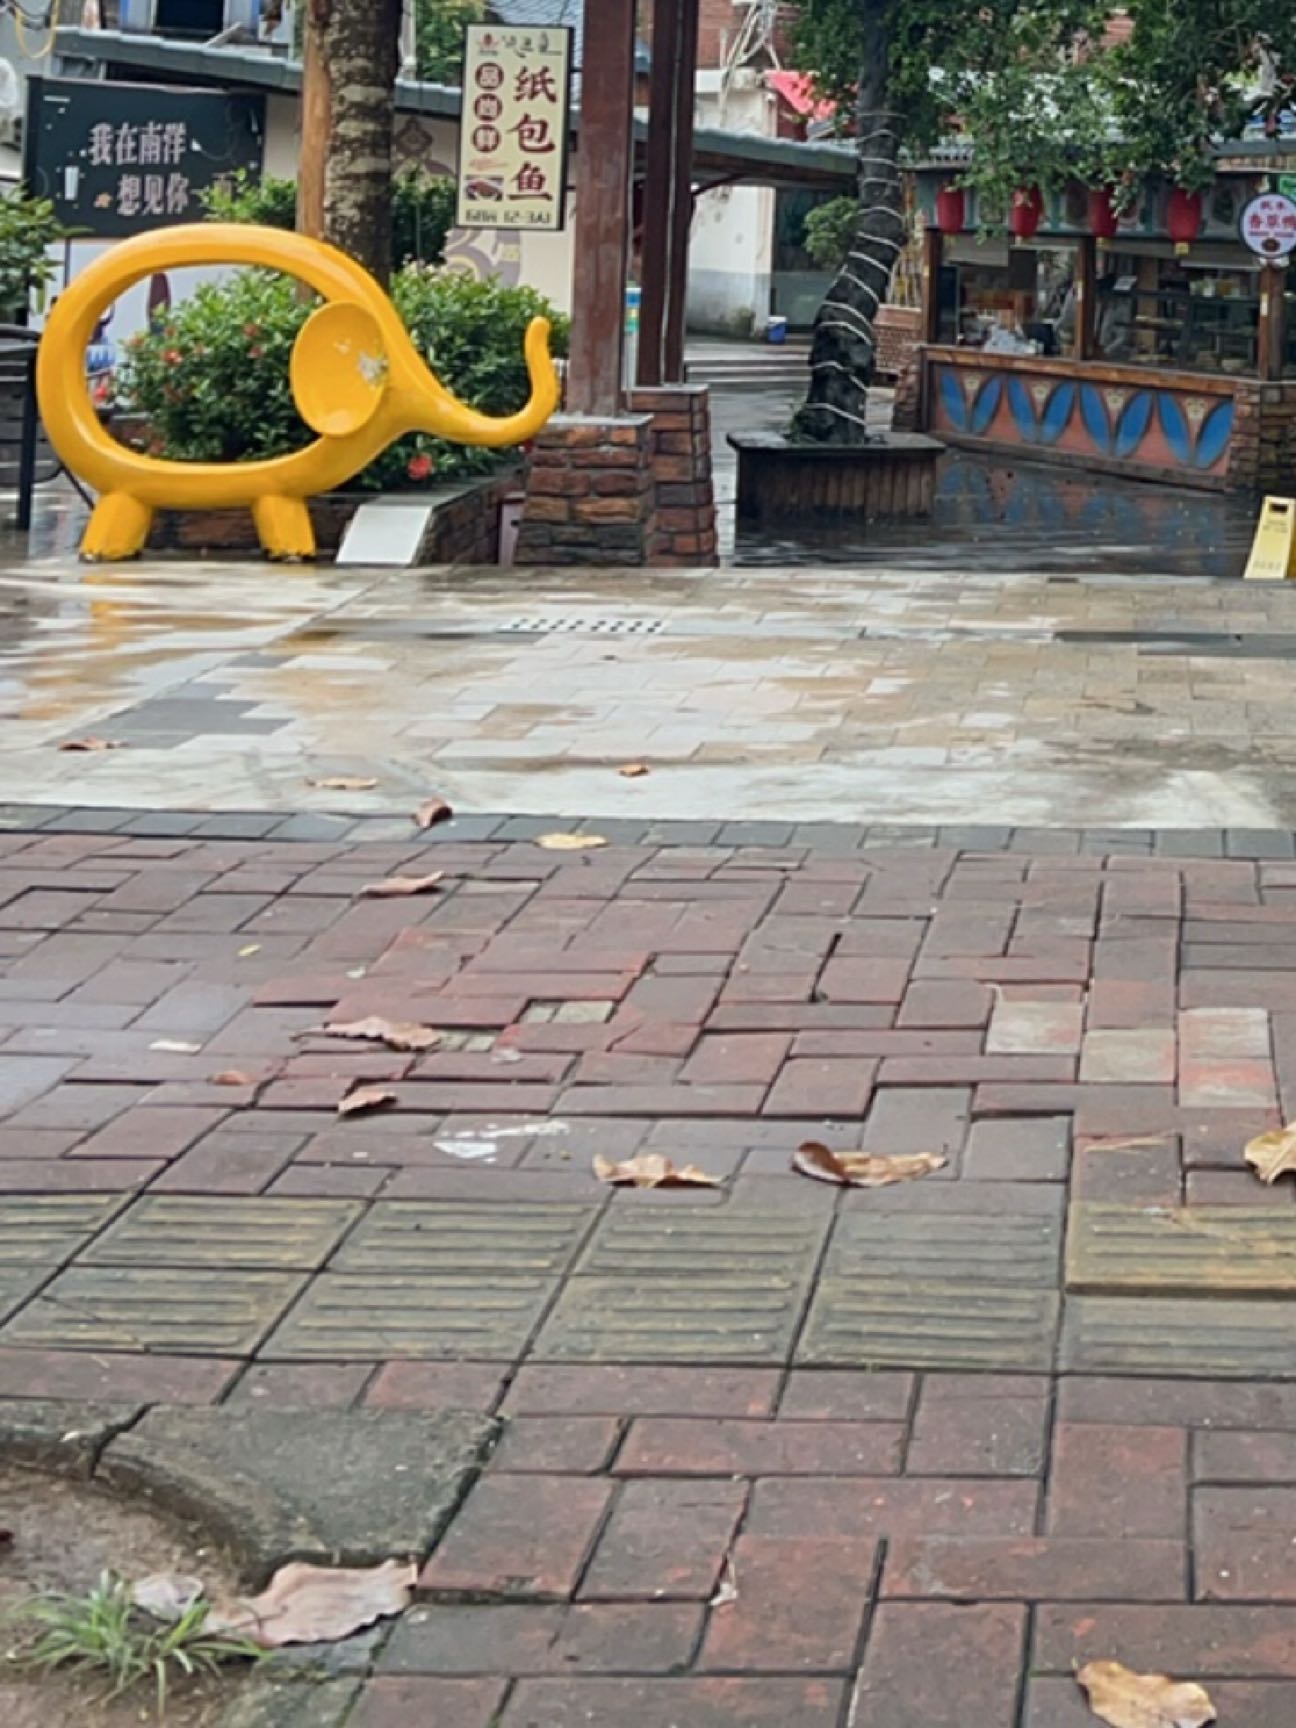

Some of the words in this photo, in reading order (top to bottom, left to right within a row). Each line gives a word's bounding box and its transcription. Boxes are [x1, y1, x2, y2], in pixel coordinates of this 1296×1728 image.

[88, 120, 188, 166] 我在南洋
[506, 65, 557, 202] 纸包鱼
[116, 172, 190, 217] 想见你
